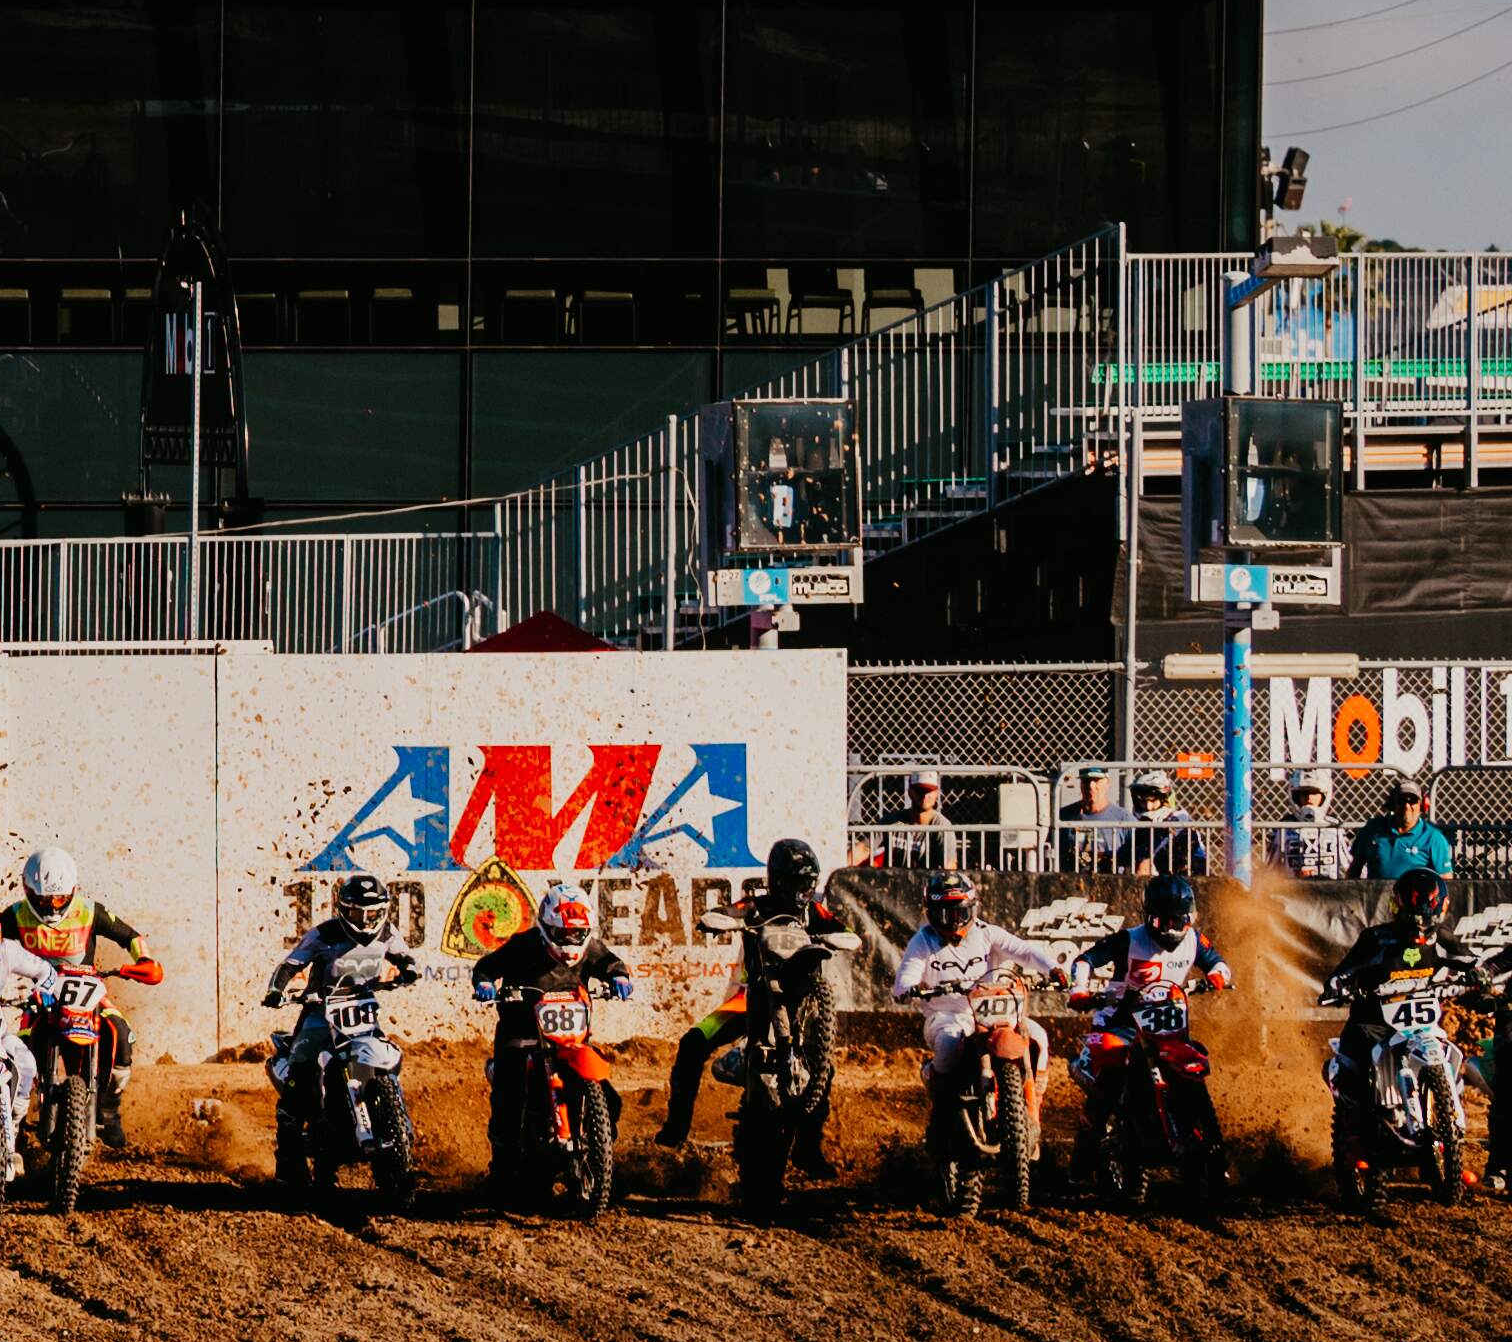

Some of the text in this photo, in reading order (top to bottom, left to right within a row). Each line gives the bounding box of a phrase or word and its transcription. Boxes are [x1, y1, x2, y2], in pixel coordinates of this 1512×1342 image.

[1269, 667, 1465, 780] Mobil
[296, 743, 767, 871] AMA
[60, 980, 99, 1007] 67
[329, 1001, 379, 1029] 108
[542, 1009, 586, 1034] 887
[1143, 1008, 1185, 1033] 38
[1392, 1001, 1436, 1027] 45
